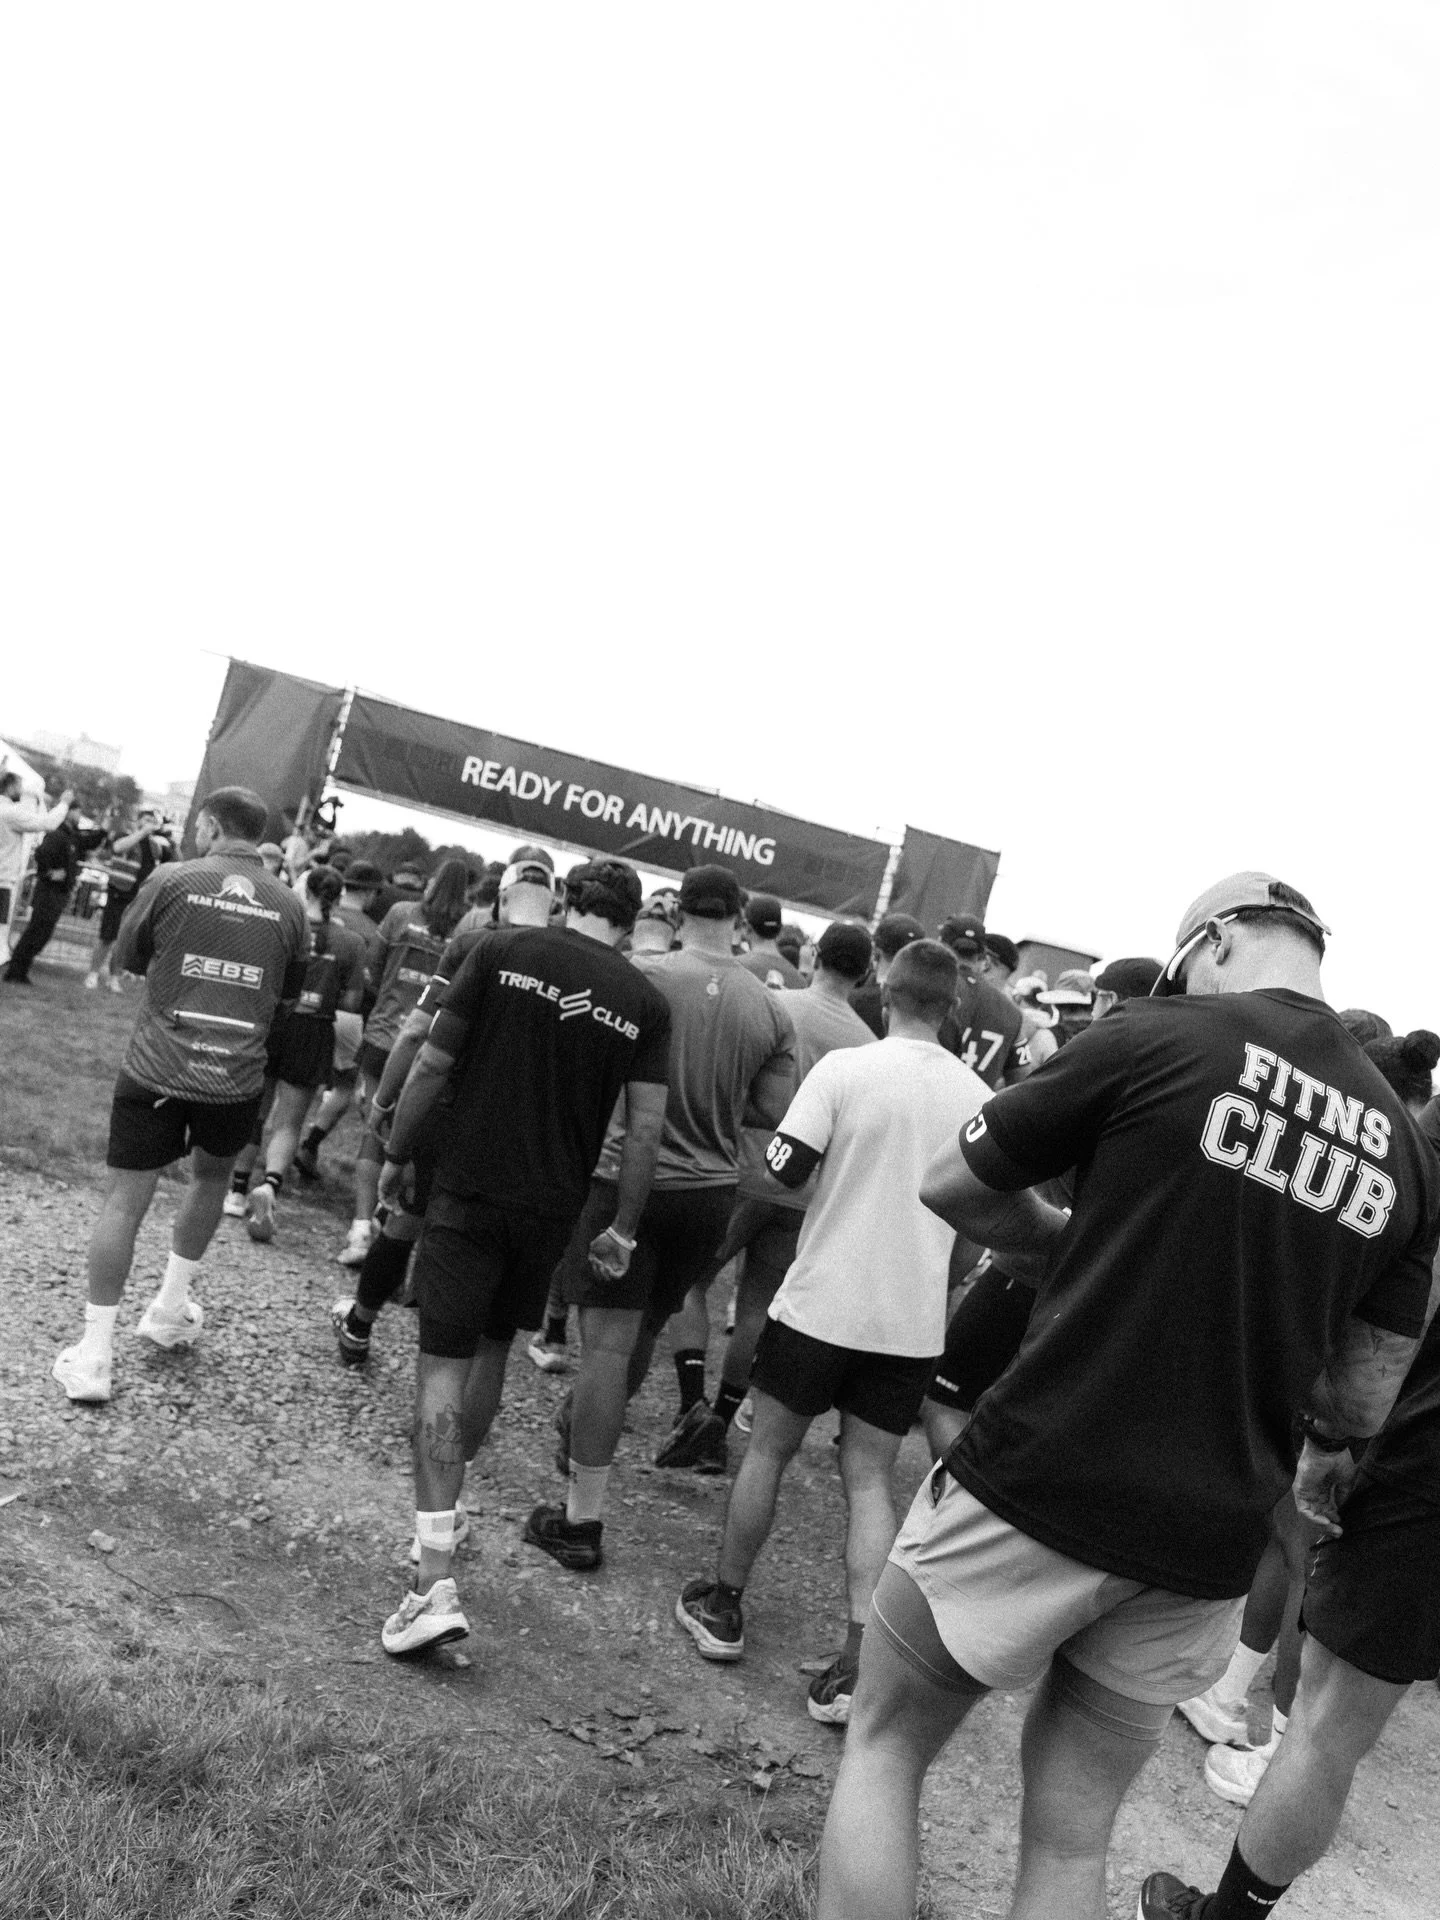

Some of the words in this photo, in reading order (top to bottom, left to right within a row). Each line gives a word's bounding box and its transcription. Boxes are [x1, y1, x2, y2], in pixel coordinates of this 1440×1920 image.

[461, 755, 562, 805] READY
[563, 784, 625, 825] FOR
[626, 803, 777, 865] ANYTHING
[187, 894, 213, 907] PEAK
[213, 899, 281, 921] PERFORMANCE
[203, 960, 260, 982] EBS
[499, 970, 561, 1002] TRIPLE
[592, 1006, 640, 1040] CLUB
[961, 1027, 1004, 1072] 47
[1239, 1042, 1391, 1160] FITNS
[766, 1136, 793, 1171] 68
[1200, 1091, 1397, 1239] CLUB
